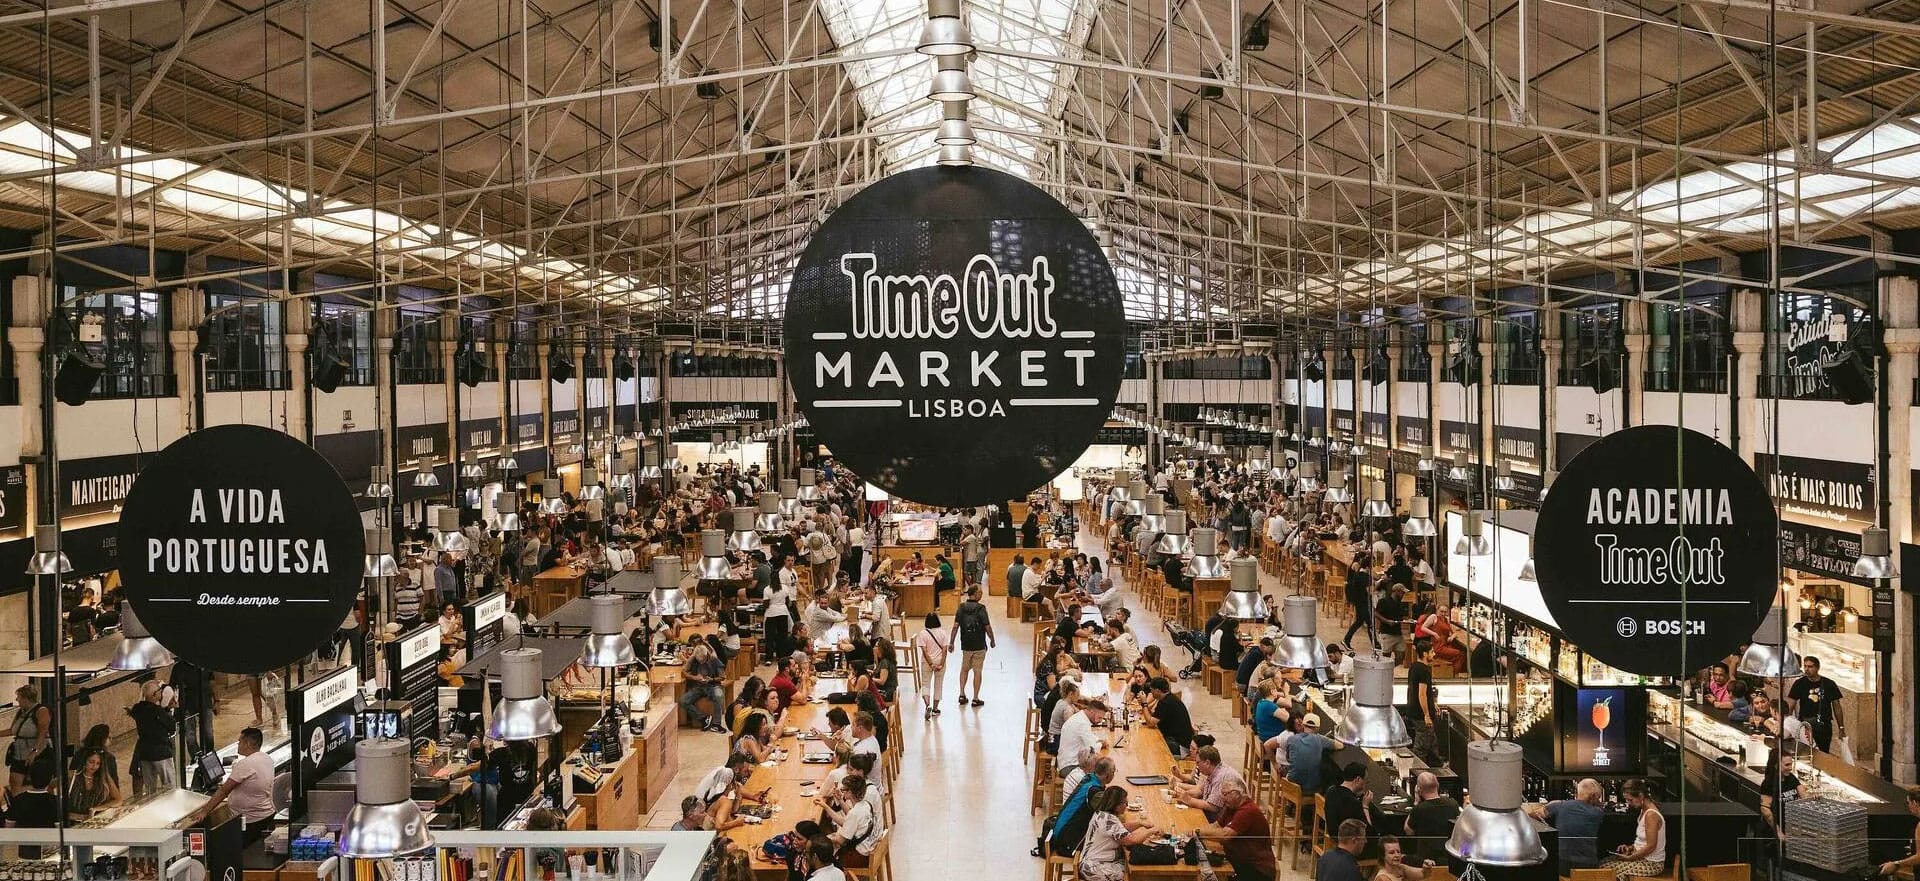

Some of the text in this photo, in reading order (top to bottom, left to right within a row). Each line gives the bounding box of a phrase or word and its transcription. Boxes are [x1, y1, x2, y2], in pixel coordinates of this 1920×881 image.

[841, 252, 1057, 339] Time Out
[1788, 313, 1833, 352] Estúdi
[815, 351, 1096, 387] MARKET
[908, 399, 1006, 418] LISBOA
[71, 473, 139, 506] MANTEIGAR
[189, 488, 285, 524] A VIDA
[1586, 487, 1734, 525] ACADEMIA
[1770, 469, 1863, 511] NÓS É MAIS BOLOS
[148, 538, 330, 574] PORTUGUESA
[1595, 534, 1668, 585] Time
[1669, 535, 1726, 585] Out
[197, 593, 281, 608] Desde sempre
[1645, 620, 1706, 635] BOSCH
